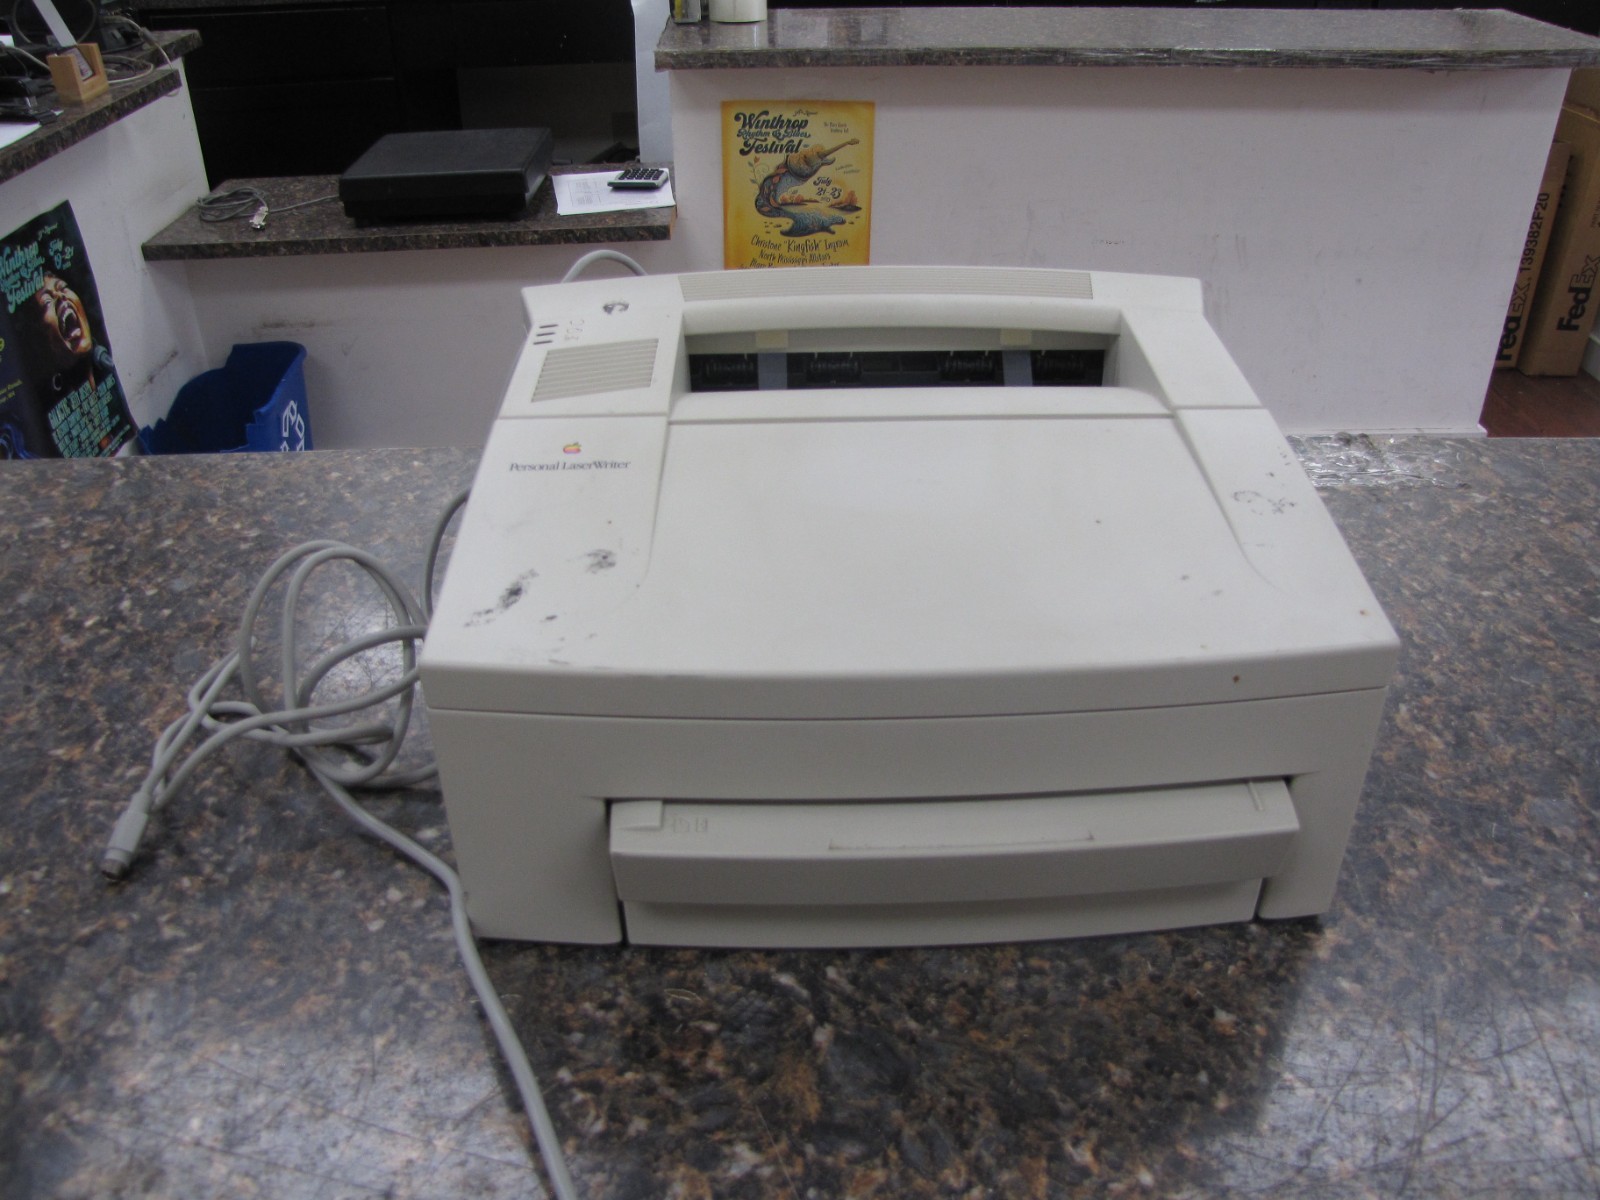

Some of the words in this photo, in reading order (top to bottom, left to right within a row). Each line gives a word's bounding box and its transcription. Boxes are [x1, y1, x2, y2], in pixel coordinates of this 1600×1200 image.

[734, 110, 808, 131] Winthrop
[737, 128, 770, 140] Rhythm
[772, 128, 782, 141] &
[781, 129, 811, 140] Blues
[739, 138, 802, 156] Festival
[813, 177, 832, 187] July
[1518, 192, 1551, 274] 139382F20
[751, 235, 782, 250] Christone
[6, 266, 45, 314] Festival
[1556, 253, 1600, 332] FedEx
[509, 461, 560, 472] Personal
[562, 460, 631, 471] LaserWriter
